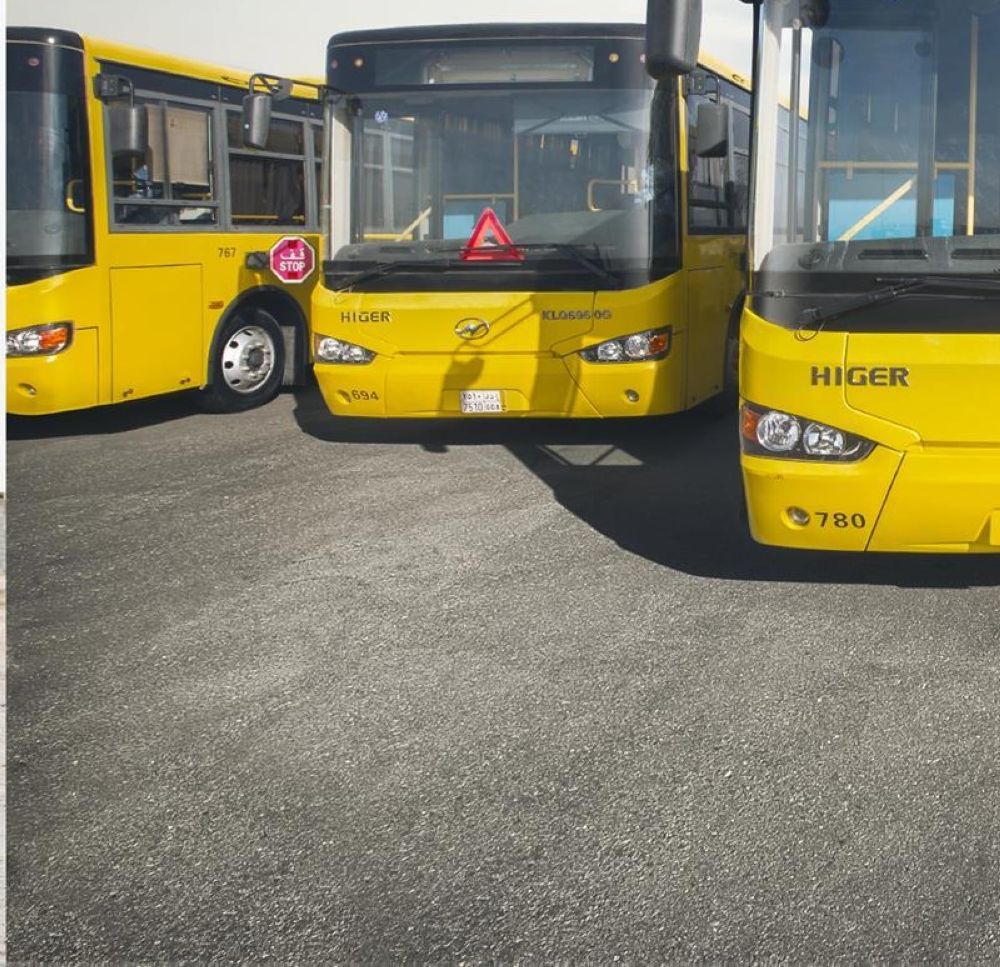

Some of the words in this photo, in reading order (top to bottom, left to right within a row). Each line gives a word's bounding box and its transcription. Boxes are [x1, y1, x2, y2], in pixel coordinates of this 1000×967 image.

[218, 247, 236, 258] 767
[279, 261, 306, 272] STOP
[340, 311, 391, 324] HIGER
[811, 365, 910, 387] HIGER
[351, 389, 379, 401] 694
[814, 512, 866, 529] 780
